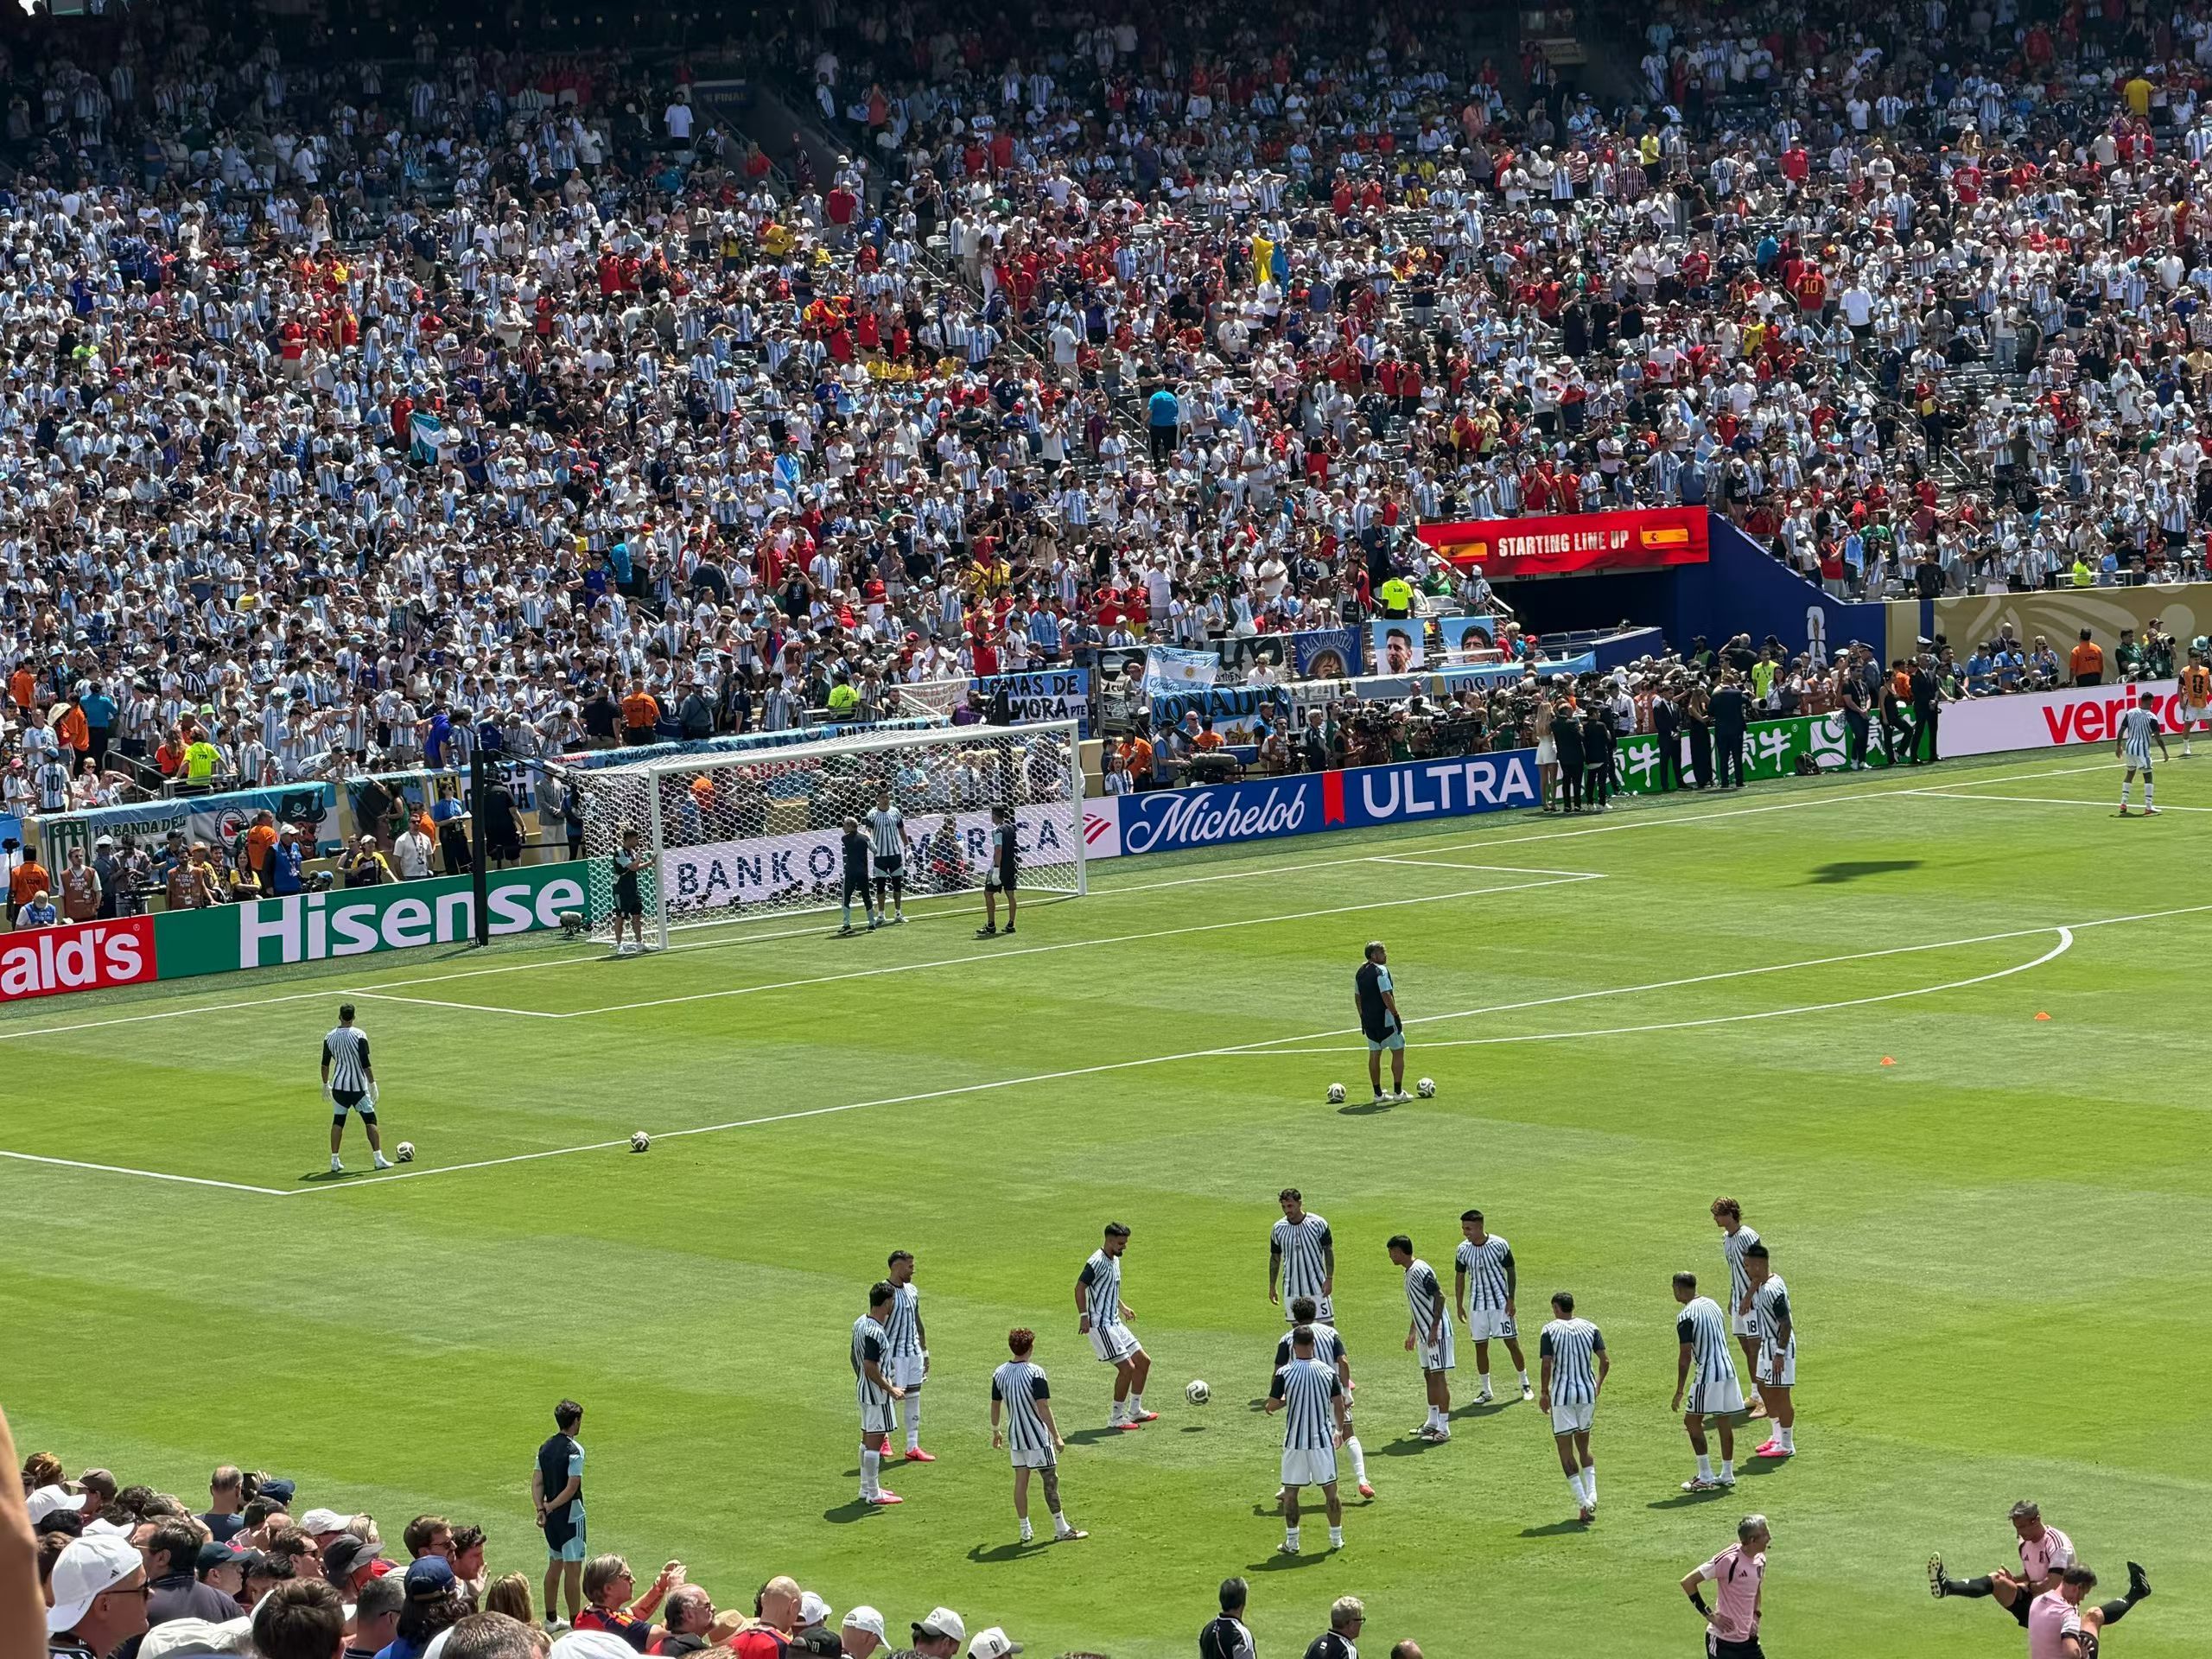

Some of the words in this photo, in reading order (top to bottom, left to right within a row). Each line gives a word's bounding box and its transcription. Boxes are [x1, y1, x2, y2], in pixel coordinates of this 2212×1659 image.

[391, 283, 404, 296] 10
[1804, 279, 1818, 294] 10
[1498, 532, 1570, 557] STARTING
[1574, 531, 1606, 551] LINE
[1610, 529, 1630, 550] UP
[1052, 674, 1079, 696] DE
[1071, 704, 1086, 716] PTE
[45, 774, 59, 791] 10
[1126, 783, 1306, 855] Michelob
[1363, 757, 1535, 818] ULTRA
[94, 824, 111, 837] LA
[113, 820, 159, 836] BANDA
[161, 813, 187, 832] DEL
[678, 850, 794, 896] BANK
[239, 878, 585, 969] Hisense
[1320, 1301, 1328, 1315] 5
[1500, 1321, 1510, 1335] 16
[1747, 1320, 1757, 1334] 18
[1429, 1354, 1440, 1368] 14
